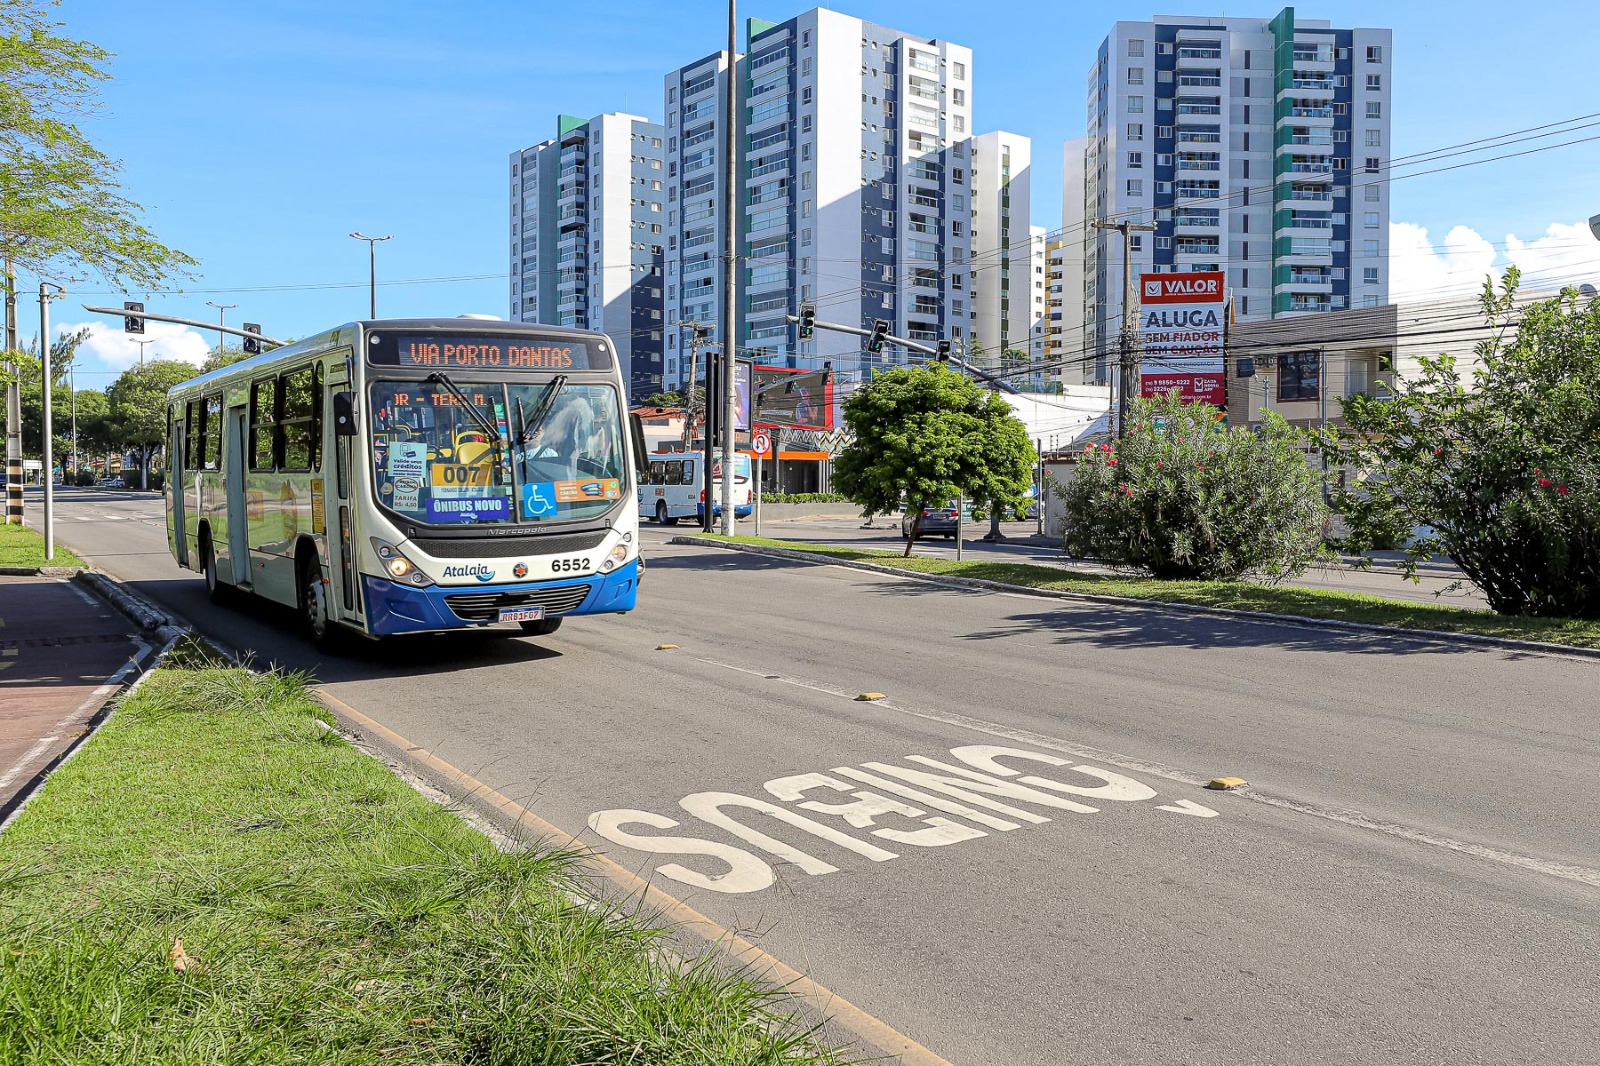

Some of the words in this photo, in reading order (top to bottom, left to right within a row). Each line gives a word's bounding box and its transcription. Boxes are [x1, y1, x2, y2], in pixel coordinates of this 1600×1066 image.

[1164, 280, 1218, 292] VALOR
[1146, 310, 1218, 328] ALUGA
[1146, 333, 1170, 343] SEM
[1173, 332, 1220, 342] FIADOR
[410, 343, 440, 365] VIA
[443, 344, 501, 366] PORTO
[508, 346, 573, 368] DANTAS
[1146, 346, 1168, 355] SEM
[1170, 343, 1220, 356] CAUÇÃO
[444, 466, 480, 484] 007
[434, 500, 473, 512] ÔNIBUS
[475, 500, 502, 511] NOVO
[488, 526, 548, 535] Marcopolo
[443, 563, 490, 578] Atalaia
[552, 558, 590, 572] 6552
